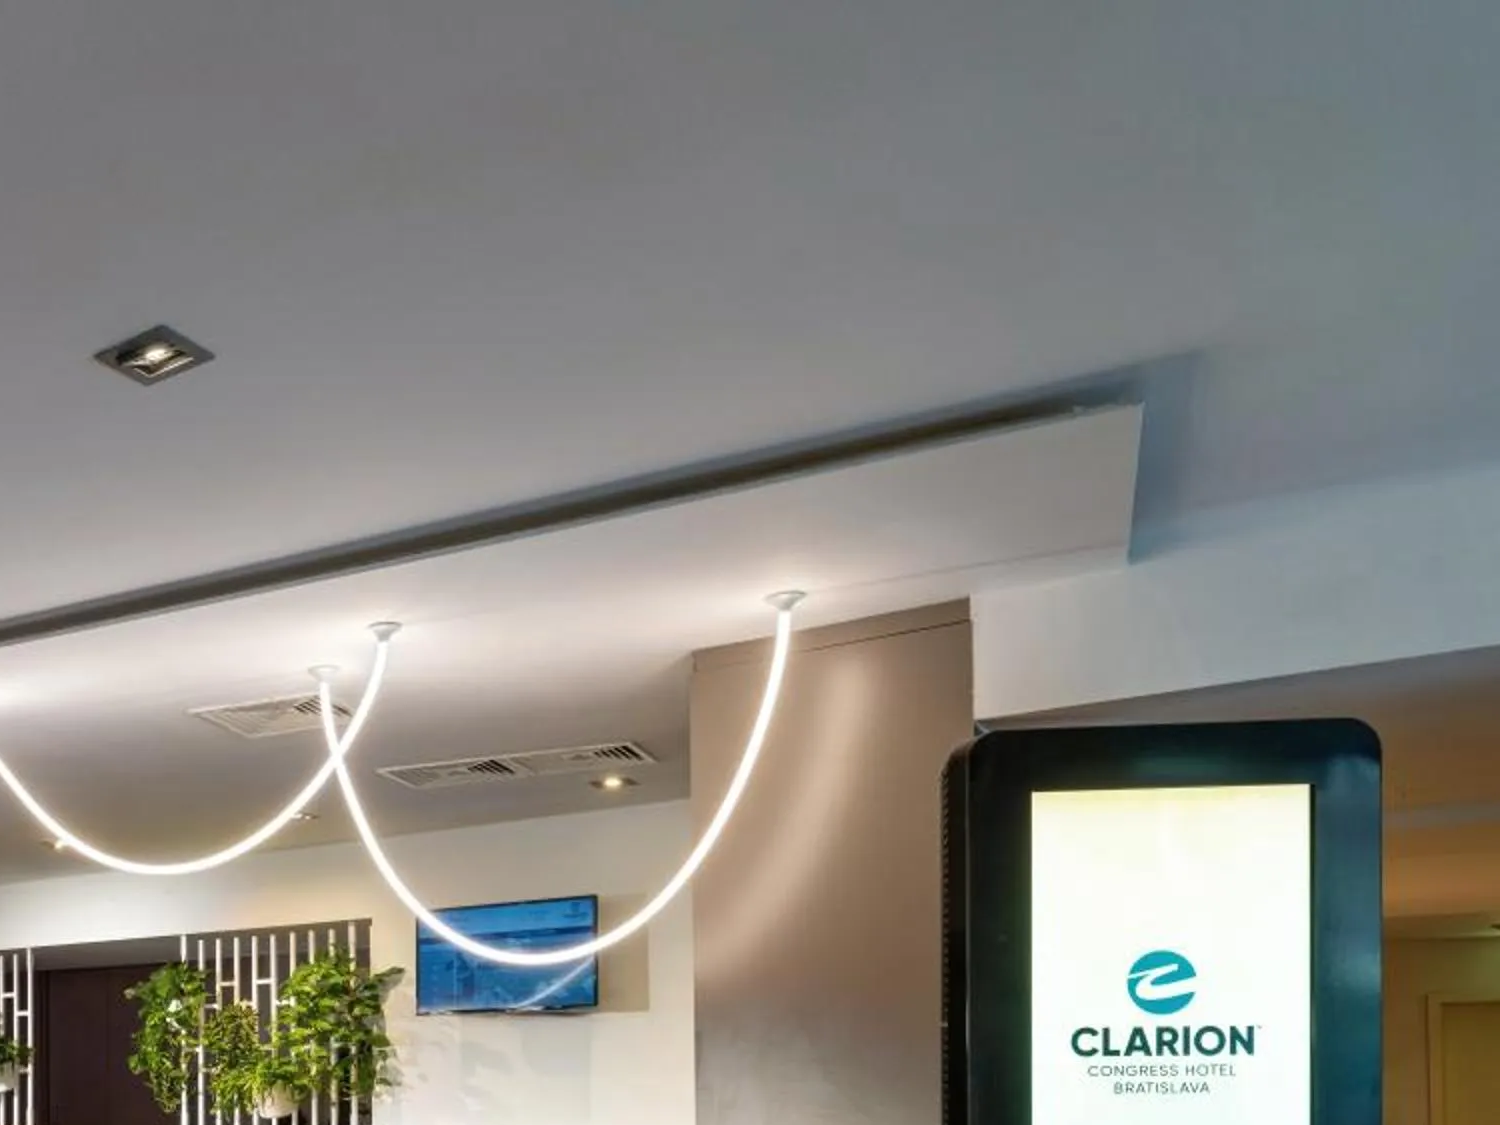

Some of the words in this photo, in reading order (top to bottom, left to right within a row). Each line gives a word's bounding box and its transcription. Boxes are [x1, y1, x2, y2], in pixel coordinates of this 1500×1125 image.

[1070, 1025, 1255, 1057] CLARION
[1087, 1064, 1179, 1078] CONGRESS
[1185, 1063, 1237, 1077] HOTEL
[1113, 1081, 1211, 1095] BRATISLAVA
